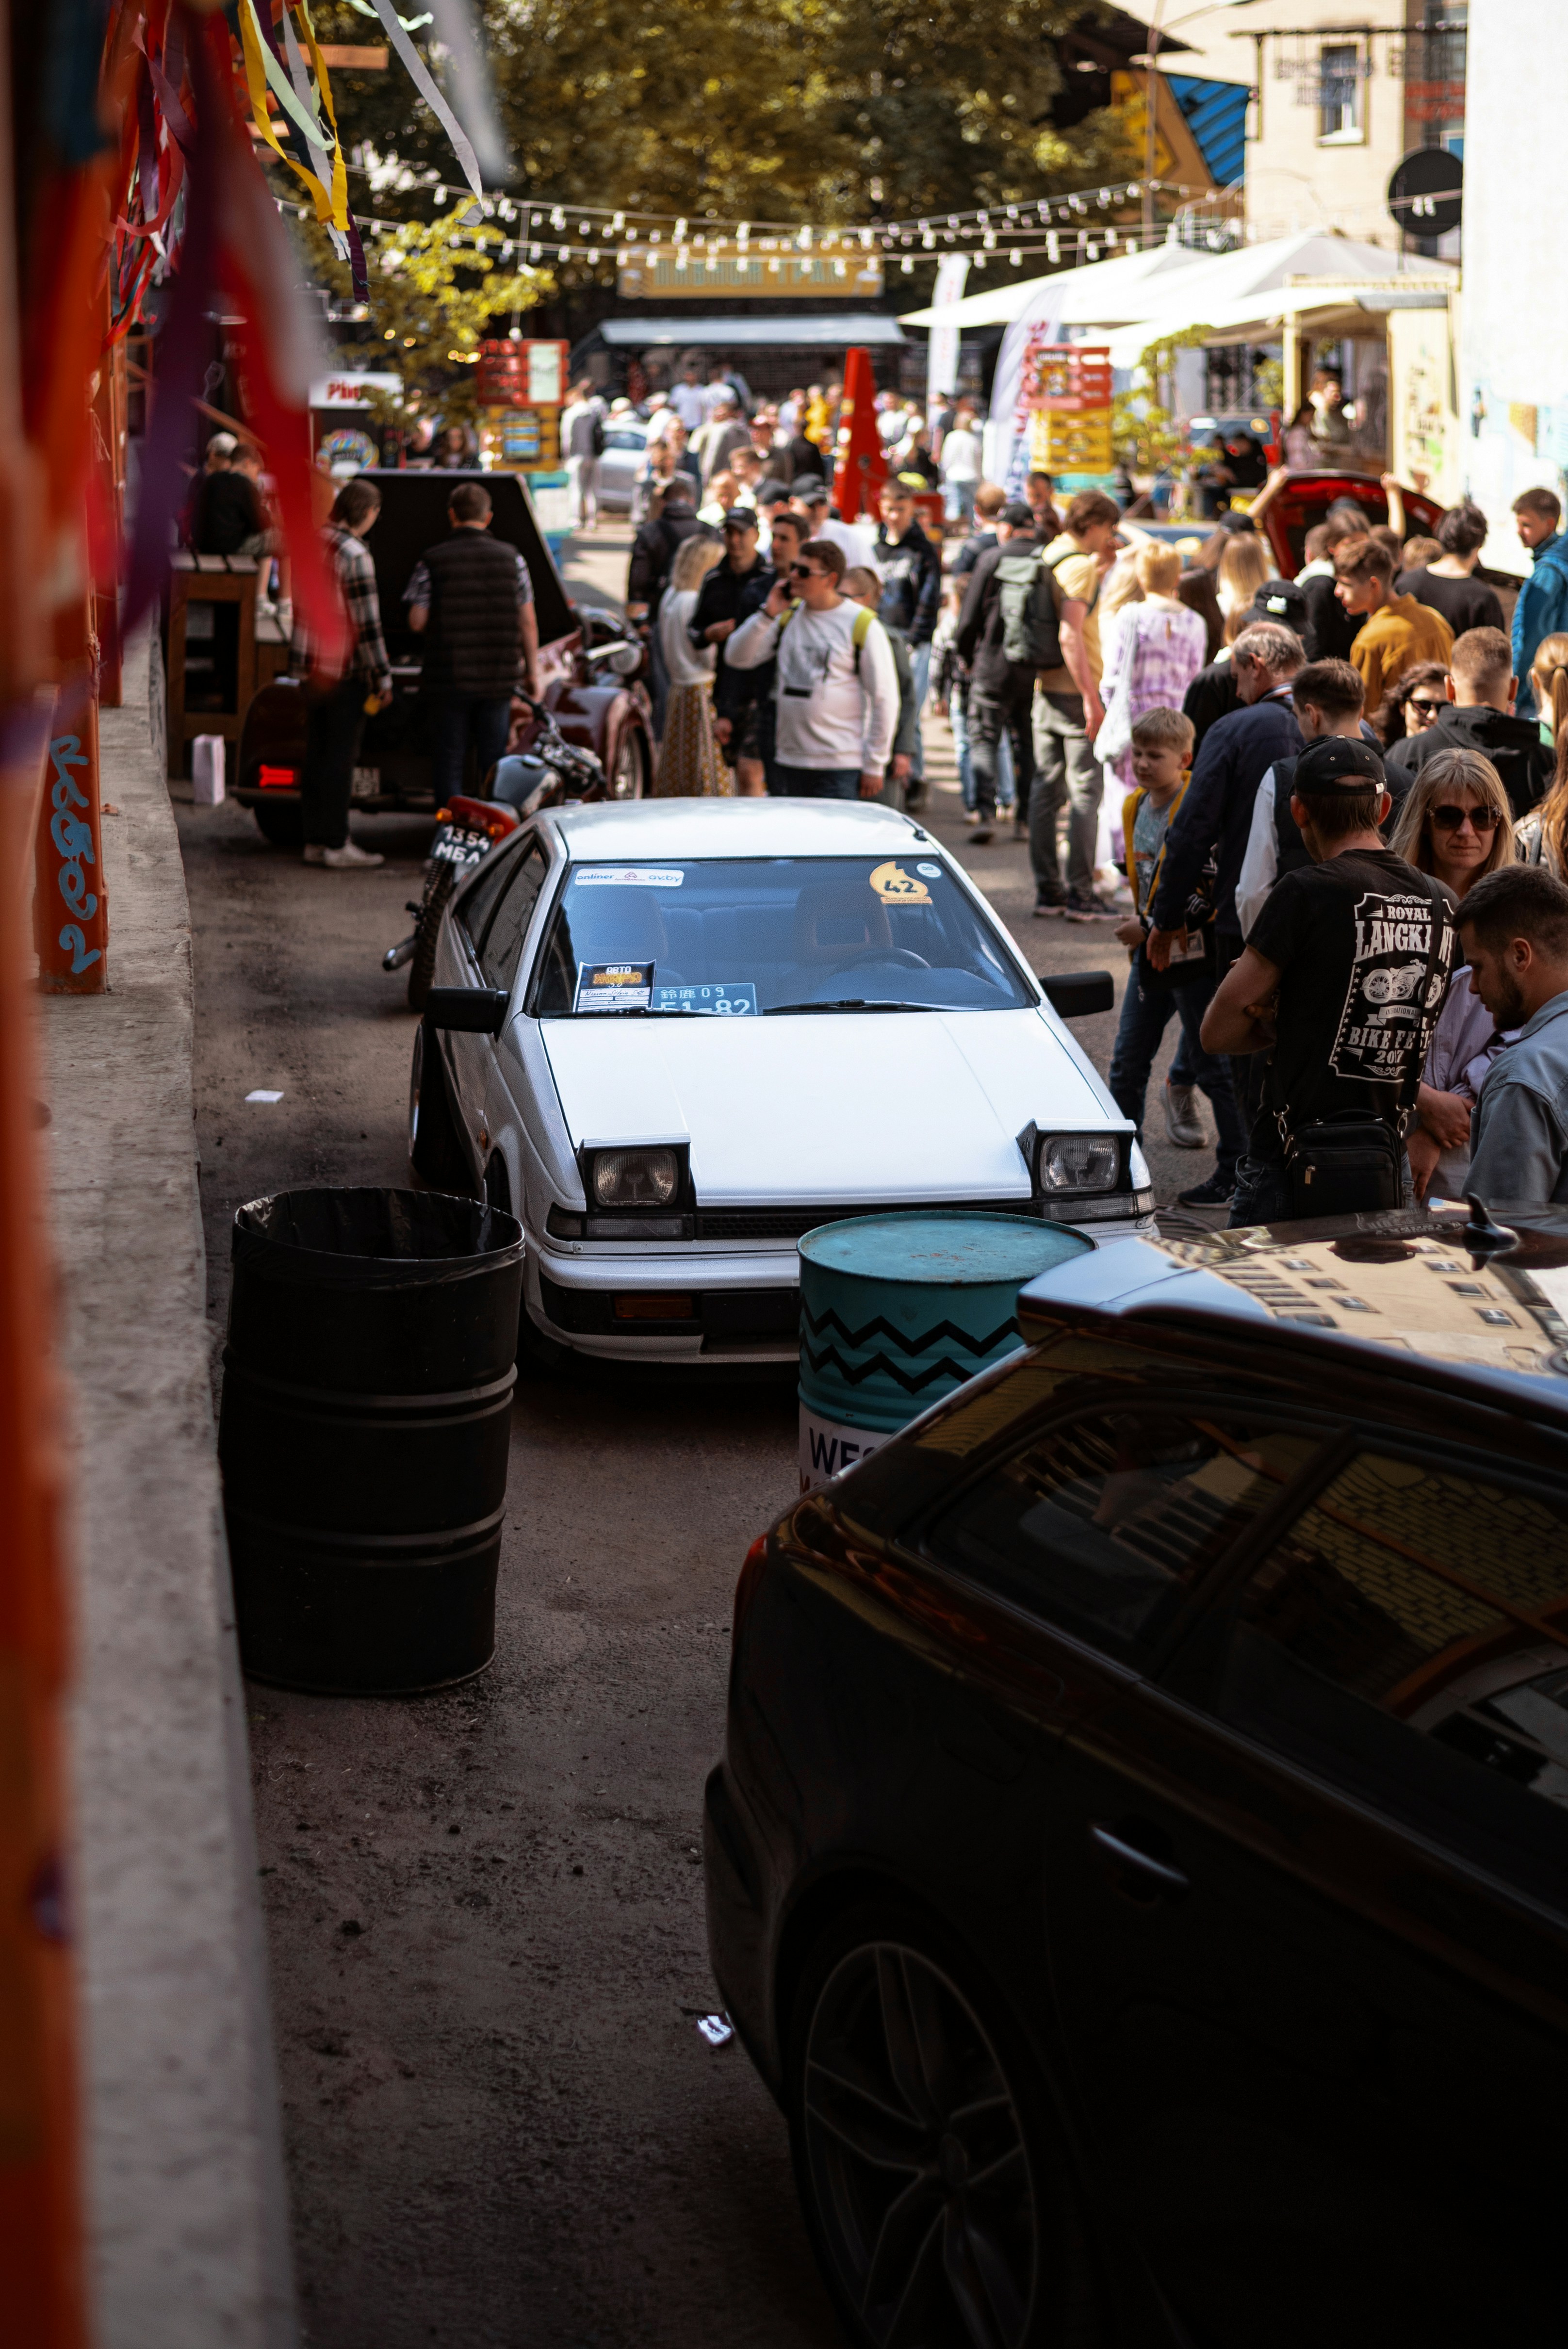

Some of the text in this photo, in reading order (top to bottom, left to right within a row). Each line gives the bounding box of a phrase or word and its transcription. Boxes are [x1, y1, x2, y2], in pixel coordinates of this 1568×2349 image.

[443, 825, 490, 851] 1354
[884, 880, 918, 893] 42
[1387, 905, 1431, 921] ROYAL
[606, 966, 631, 974] АВТО
[593, 972, 642, 984] ЖАРА
[660, 989, 696, 999] 鈴鹿
[1348, 1026, 1391, 1049] BIKE
[1374, 1049, 1405, 1063] 2017
